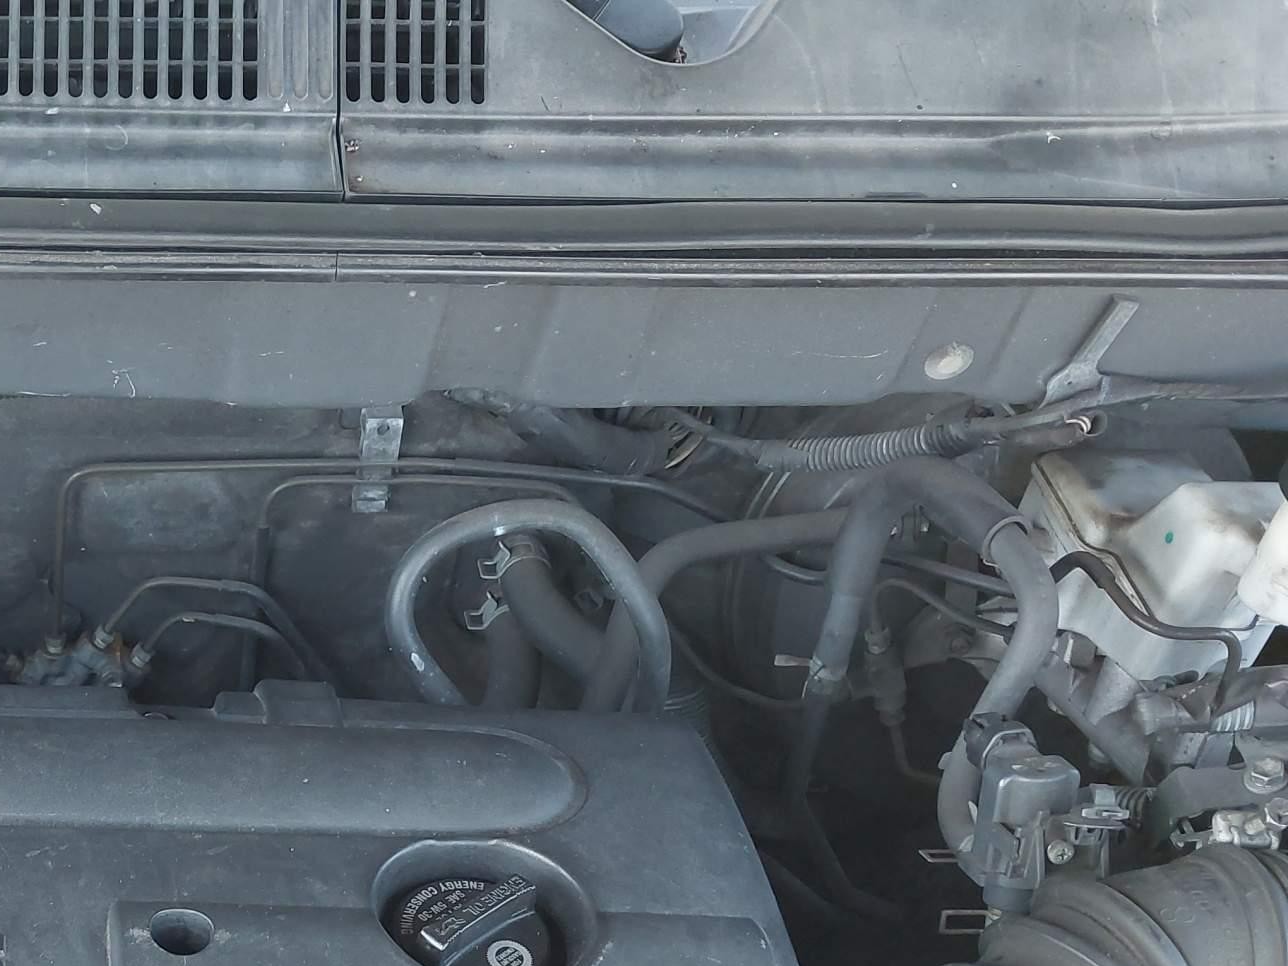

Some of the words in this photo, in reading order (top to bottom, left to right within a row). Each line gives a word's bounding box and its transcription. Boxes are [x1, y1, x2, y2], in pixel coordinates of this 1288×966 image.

[439, 880, 485, 893] ENERGY
[480, 876, 526, 907] ENGINE
[444, 889, 466, 905] SAE
[399, 886, 438, 935] CONSERVING
[417, 900, 447, 922] 5W-30
[462, 901, 487, 916] OIL
